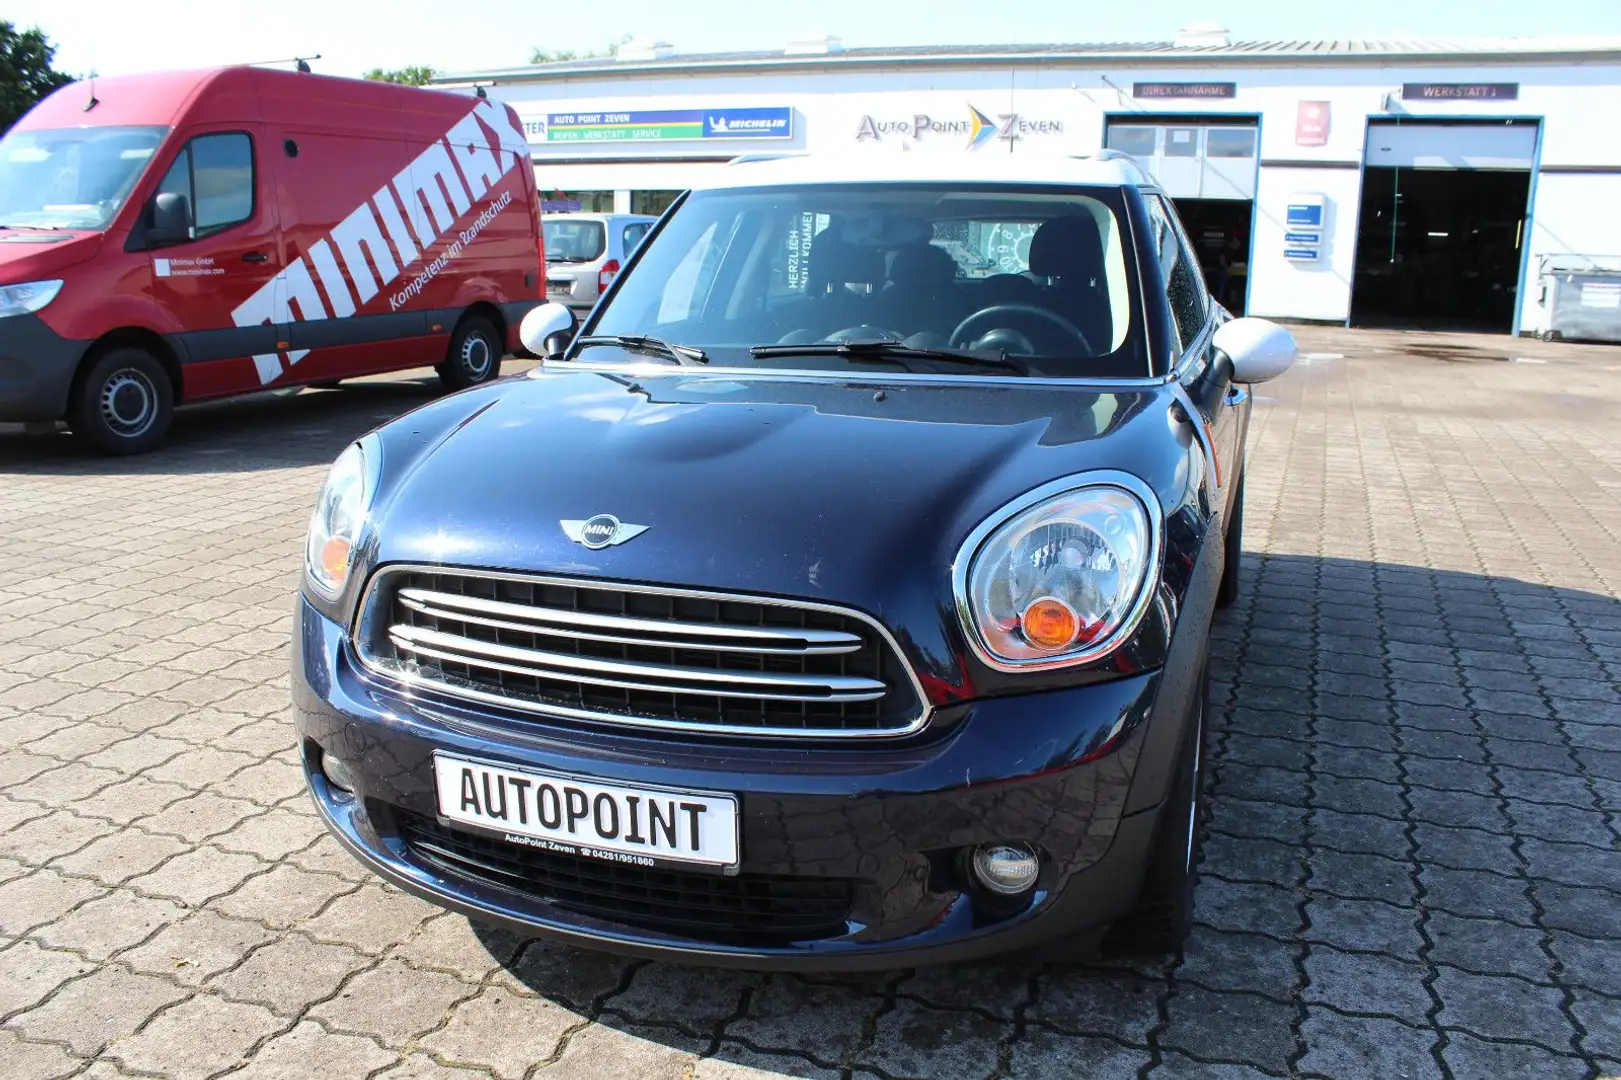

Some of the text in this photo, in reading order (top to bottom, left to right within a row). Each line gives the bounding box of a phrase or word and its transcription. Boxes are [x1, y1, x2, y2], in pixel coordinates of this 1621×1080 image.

[1423, 86, 1489, 97] WERKSTATT
[525, 122, 546, 135] TER
[553, 113, 631, 124] AUTO POINT ZEVEN
[729, 119, 787, 129] MICHELIN
[856, 113, 1061, 140] AUTO POINT ZEVEN
[583, 129, 626, 139] WERKSTATT
[632, 128, 662, 138] SERVICE
[230, 100, 529, 385] MINIMAX
[389, 190, 512, 312] Kompetenz im Brandschutz
[788, 230, 799, 289] HERZLICH
[584, 524, 615, 536] MINI
[460, 767, 708, 851] AUTOPOINT
[504, 833, 655, 867] AutoPoint Zeven 04281/951860
